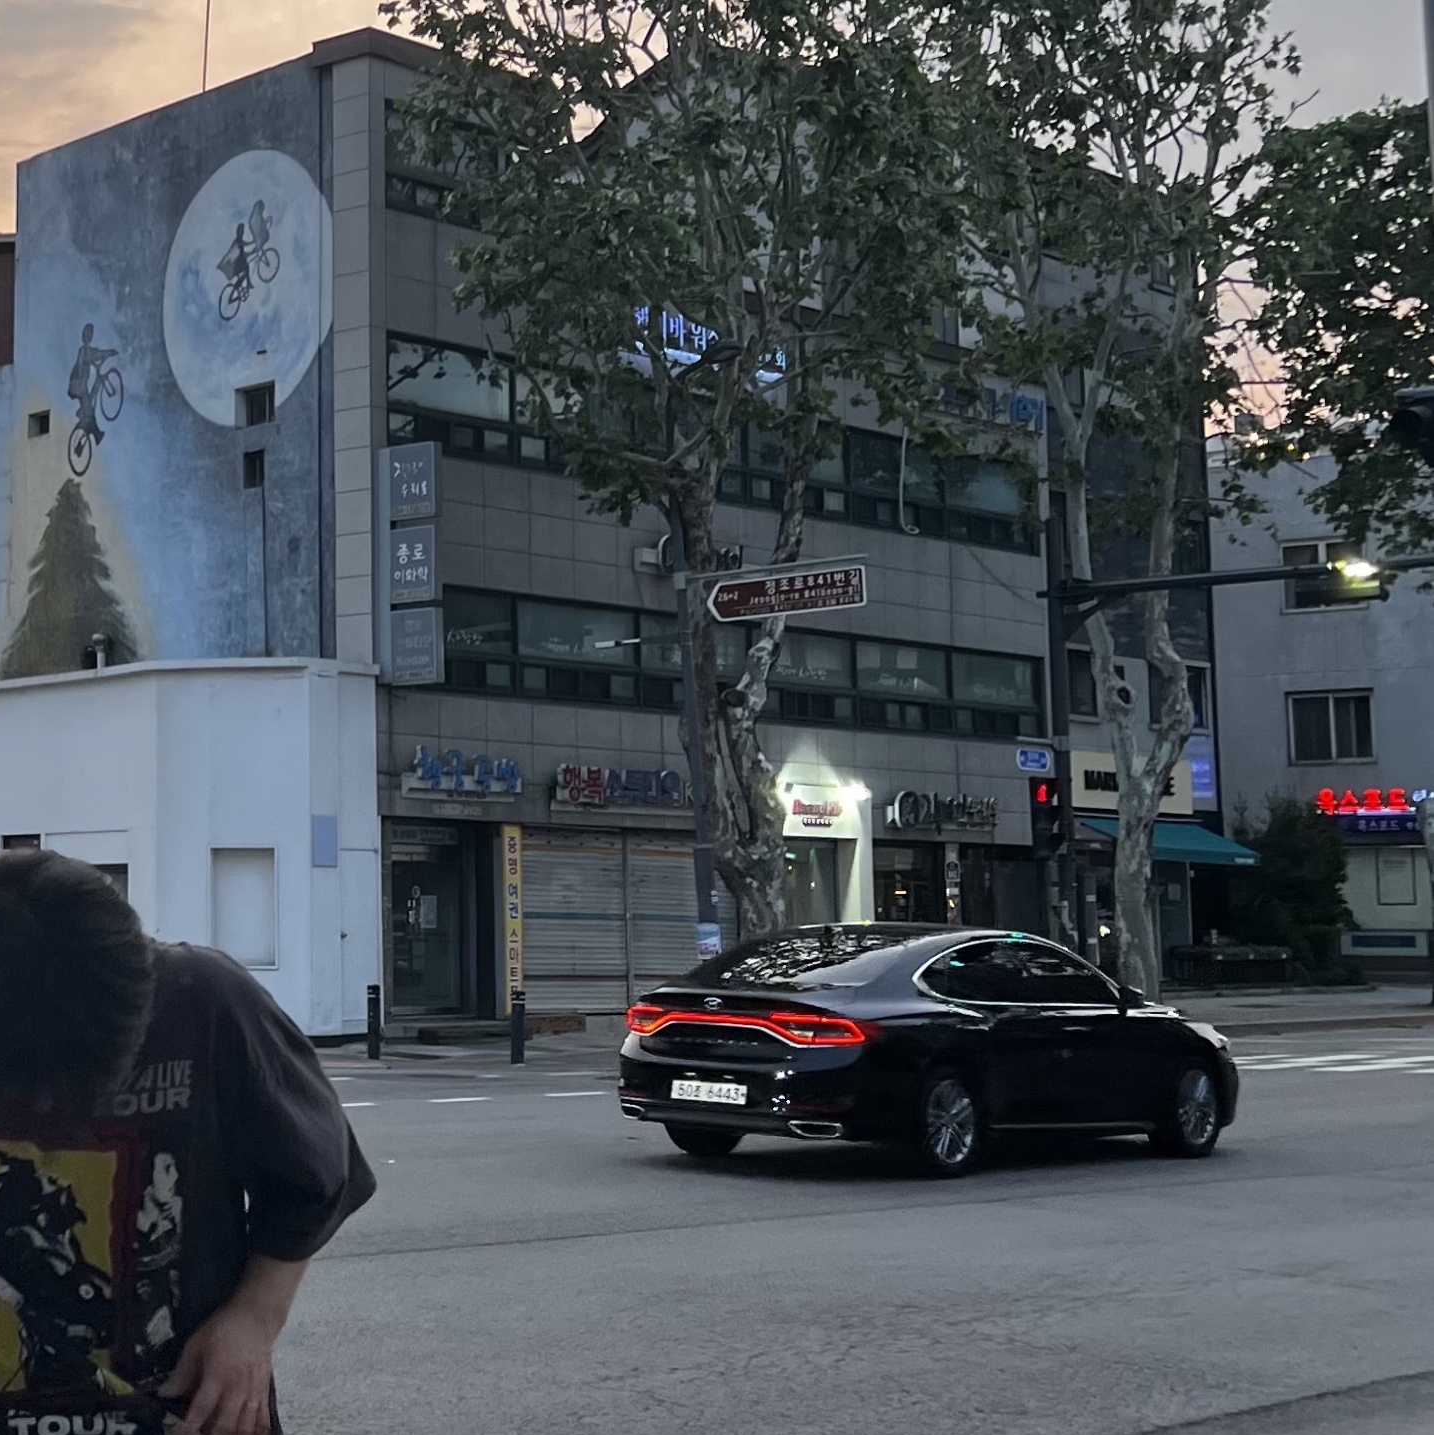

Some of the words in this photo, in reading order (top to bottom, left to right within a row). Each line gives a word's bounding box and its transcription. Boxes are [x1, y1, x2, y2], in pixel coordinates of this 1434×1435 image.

[396, 543, 426, 565] 종로
[765, 569, 861, 595] 정조로841번길
[507, 835, 517, 876] 증명
